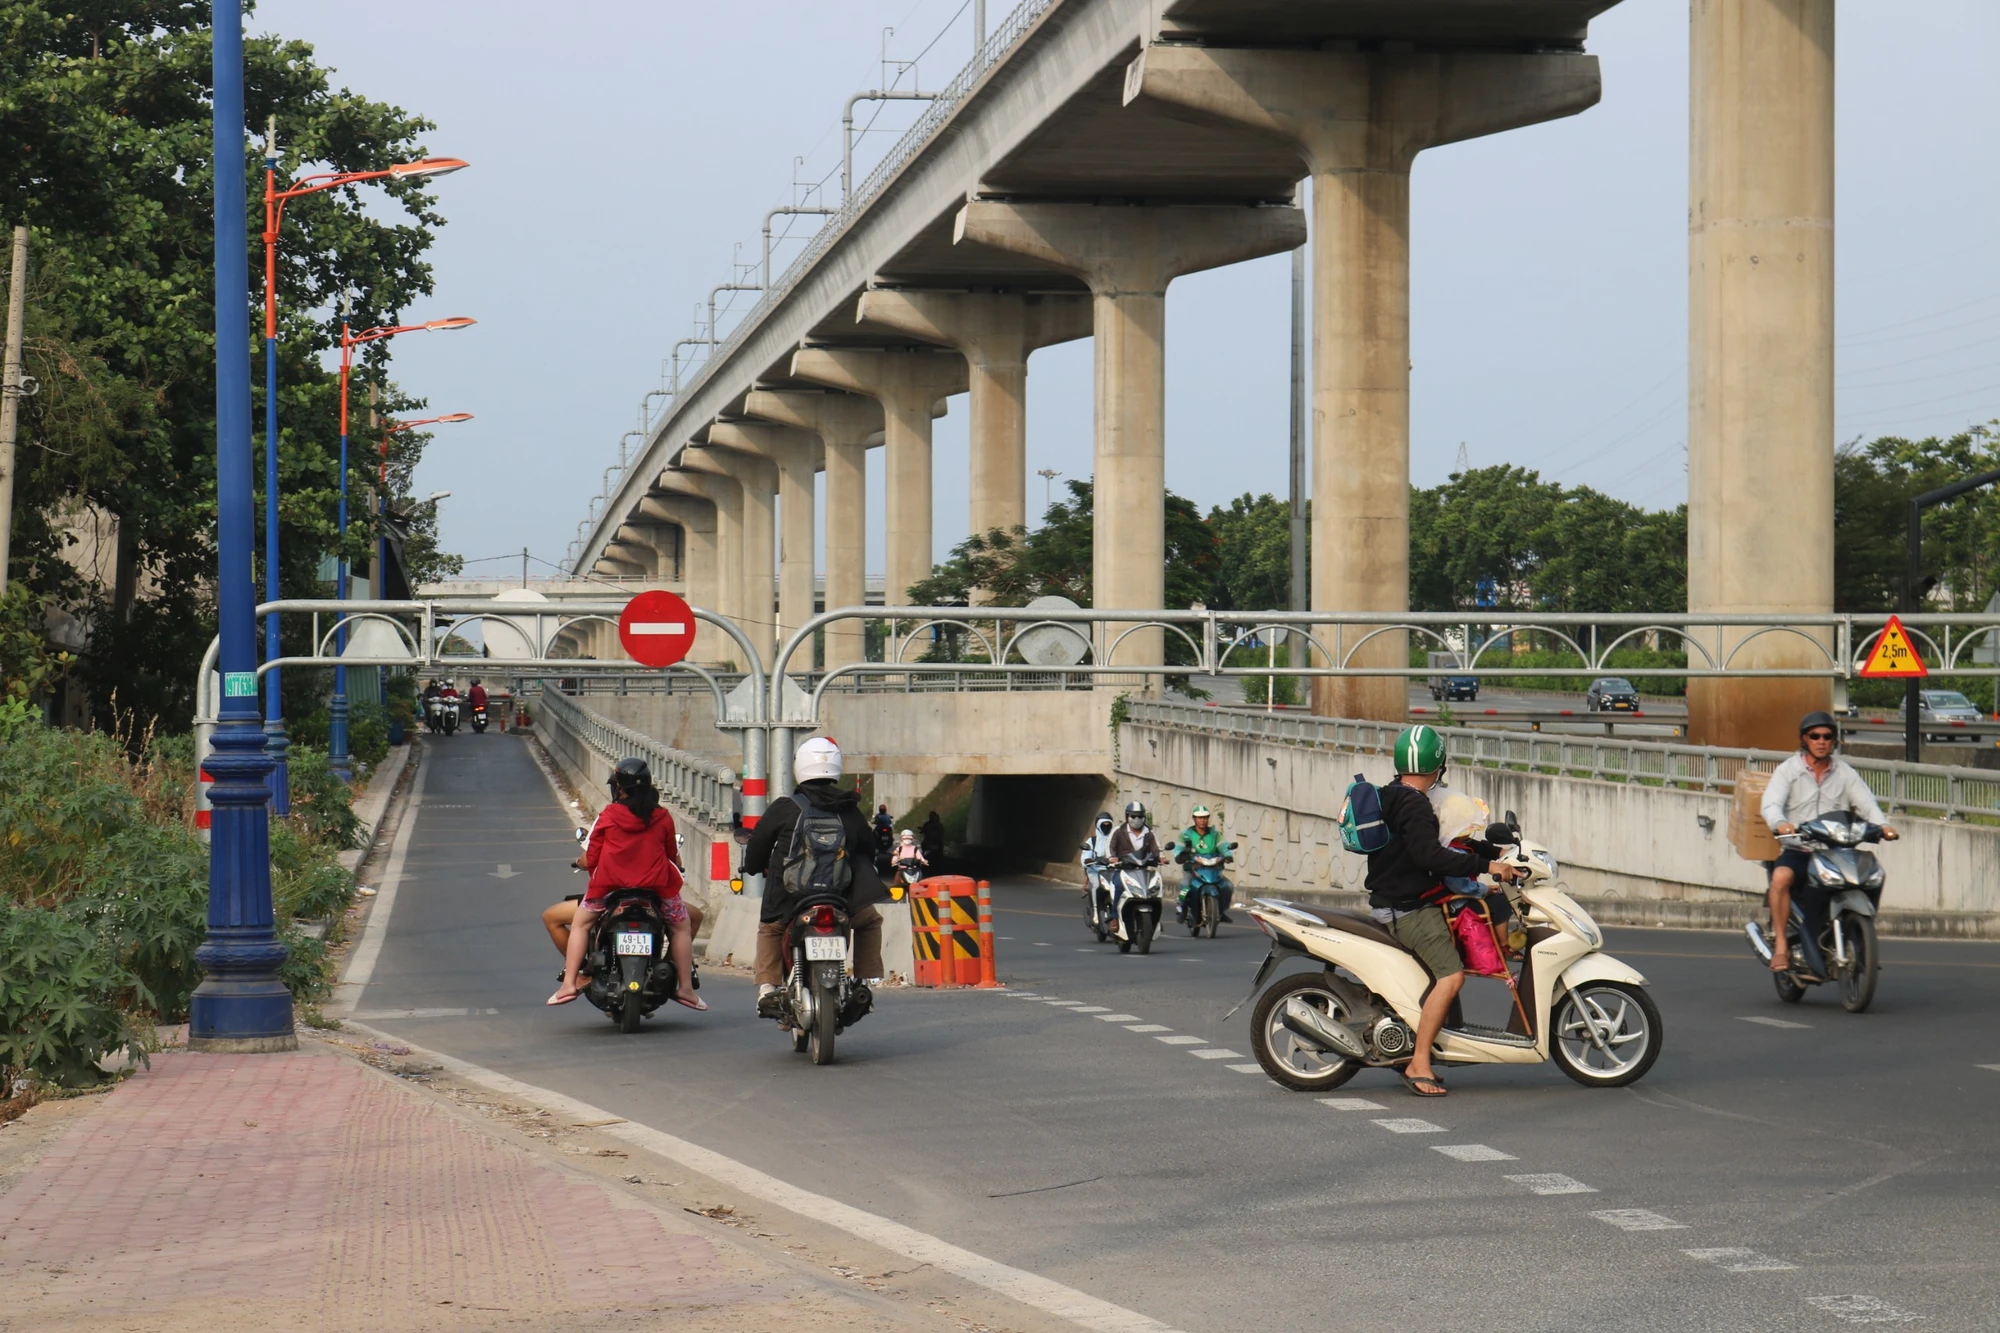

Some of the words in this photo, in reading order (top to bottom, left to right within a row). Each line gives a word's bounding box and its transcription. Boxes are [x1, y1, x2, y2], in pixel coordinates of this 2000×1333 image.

[1882, 644, 1908, 659] 2,5m
[622, 934, 647, 944] 49-L1
[811, 938, 841, 948] 67-V1
[619, 944, 650, 954] 082.26
[812, 948, 842, 959] 5176
